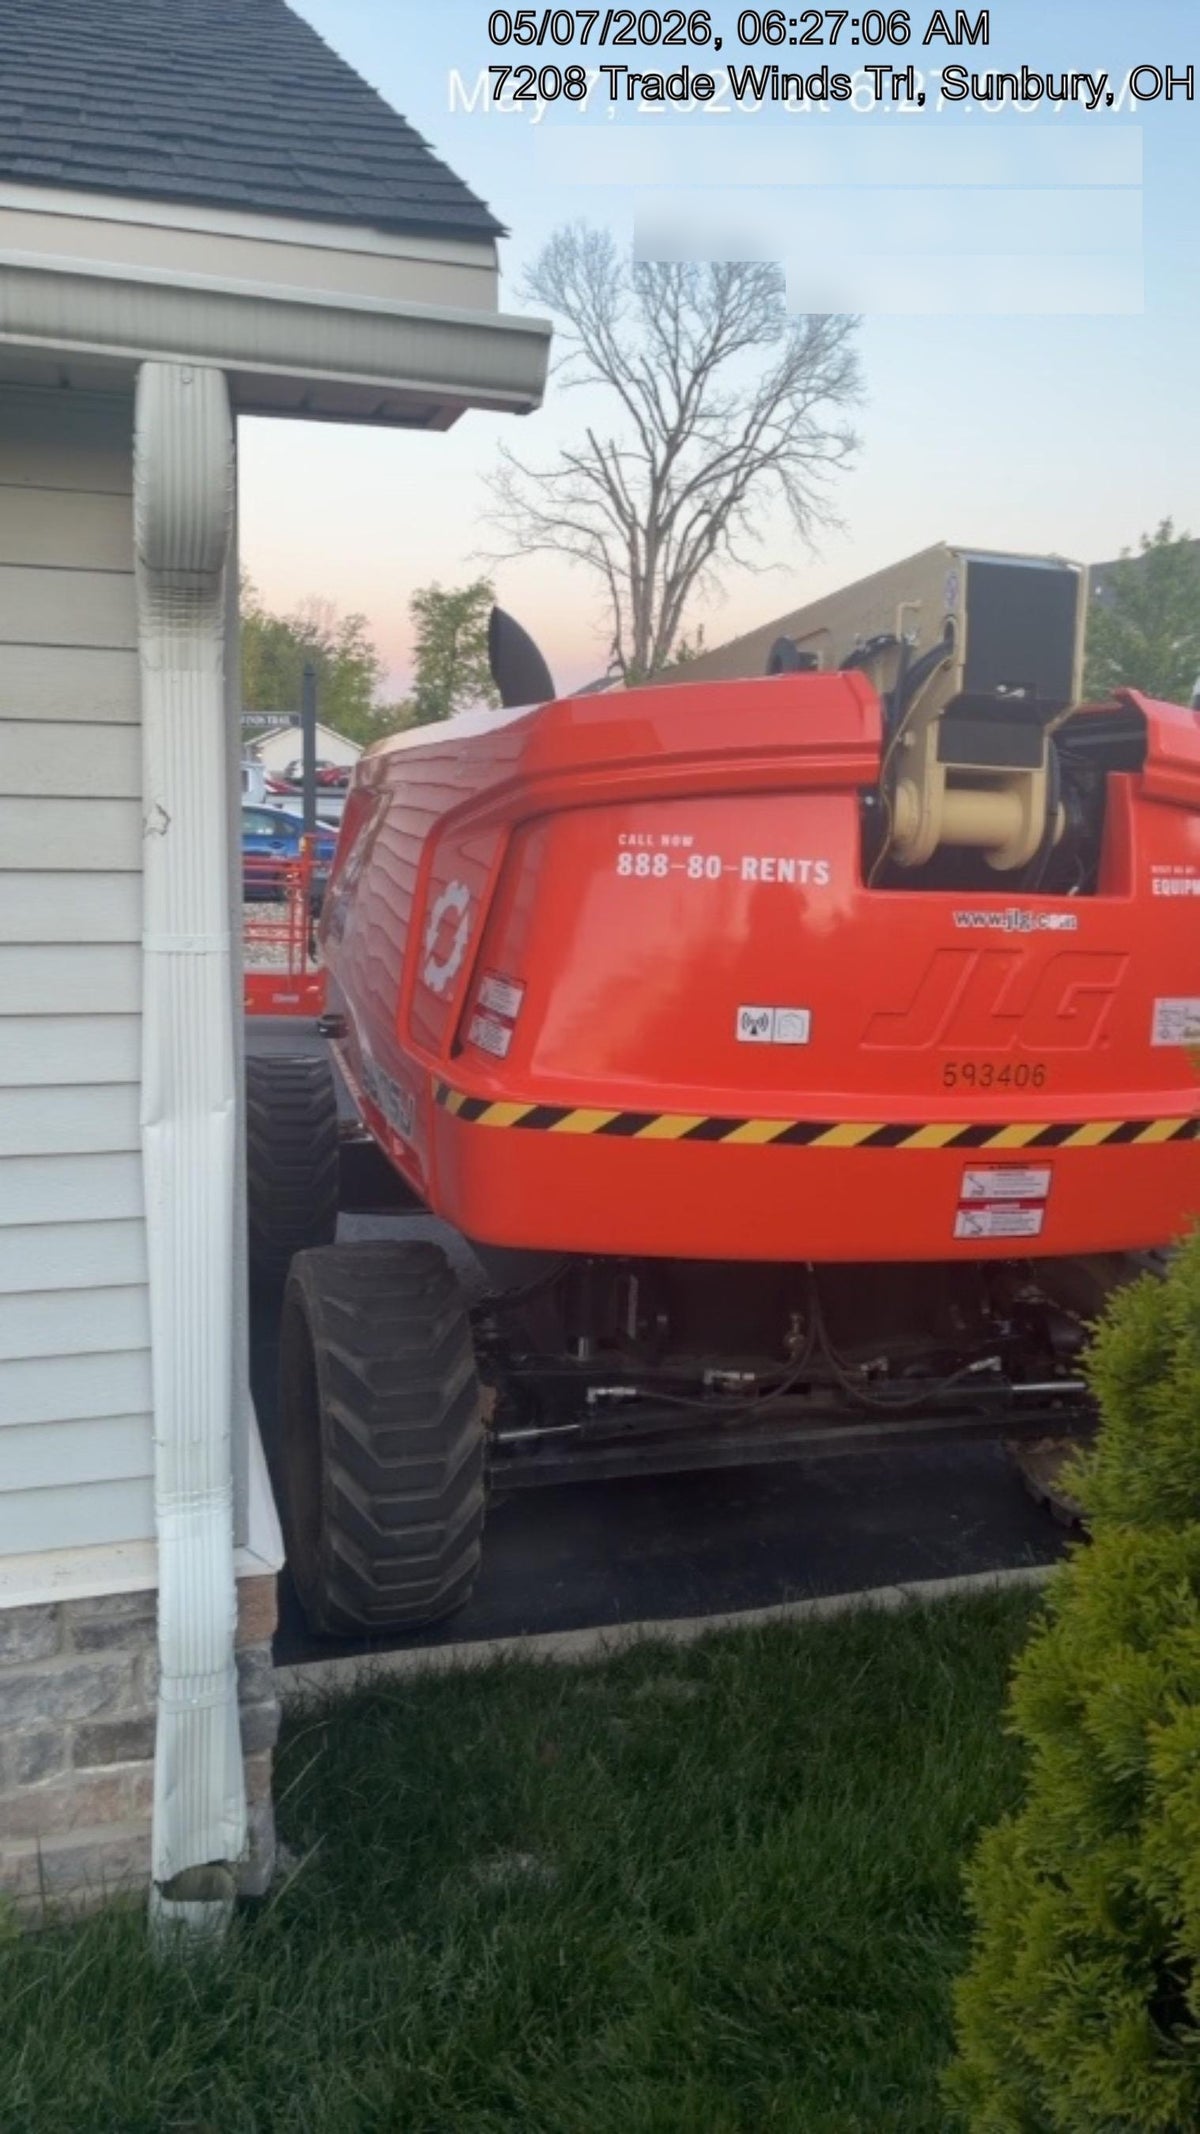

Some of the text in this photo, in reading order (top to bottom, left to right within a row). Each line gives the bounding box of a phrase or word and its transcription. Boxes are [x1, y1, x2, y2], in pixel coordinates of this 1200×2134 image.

[618, 834, 693, 847] CALL NOW
[616, 852, 830, 885] 888-80-RENTS
[859, 947, 1131, 1050] JLG
[943, 1062, 1047, 1087] 593406
